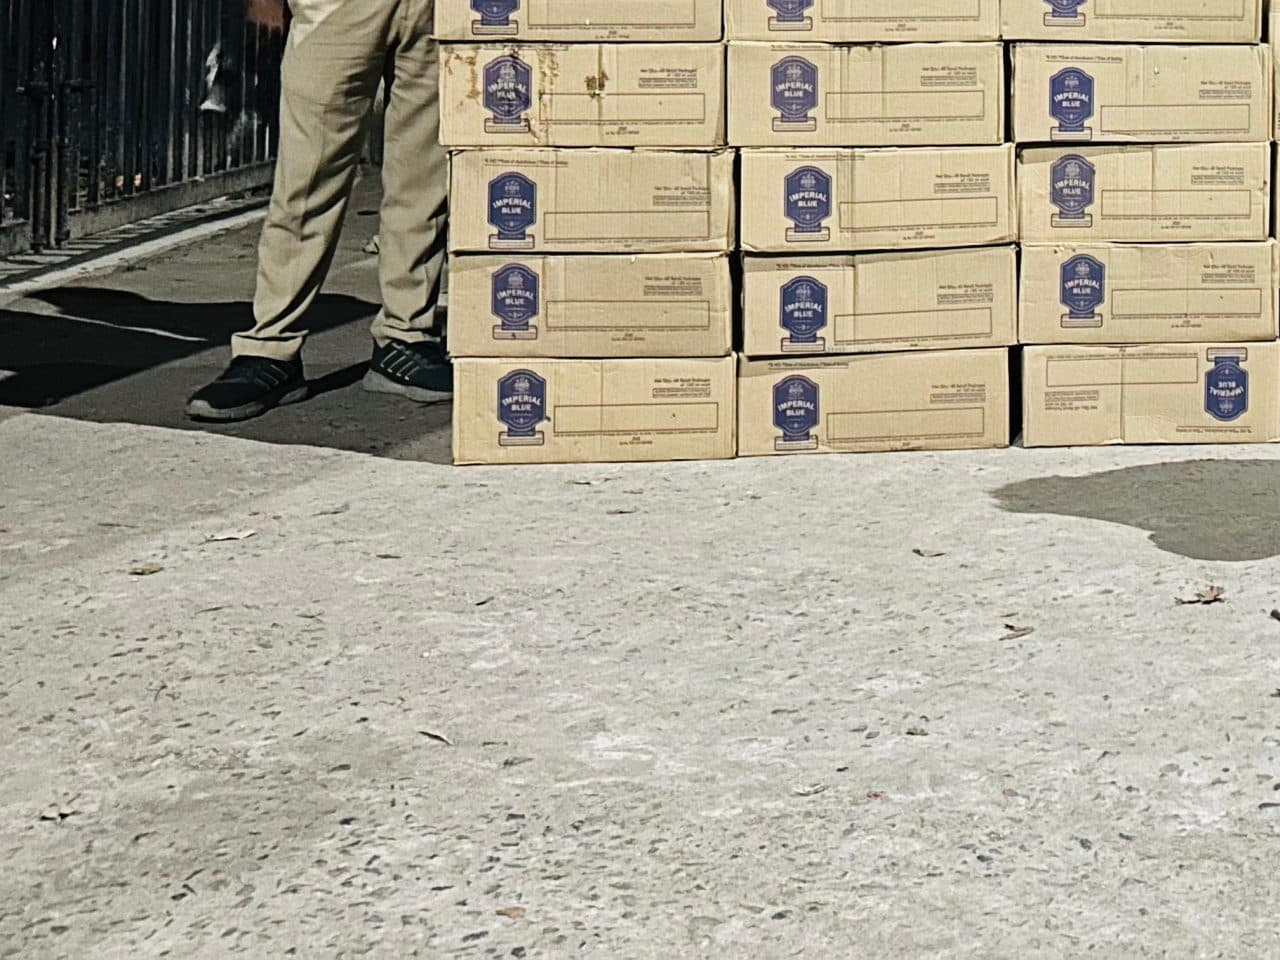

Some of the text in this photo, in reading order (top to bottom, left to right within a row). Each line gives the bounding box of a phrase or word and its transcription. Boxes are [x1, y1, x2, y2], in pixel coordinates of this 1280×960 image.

[775, 81, 813, 93] IMPERIAL
[1053, 92, 1089, 103] IMPERIAL
[1054, 179, 1090, 190] IMPERIAL
[788, 191, 827, 202] IMPERIAL
[492, 197, 531, 209] IMPERIAL
[1064, 278, 1100, 290] IMPERIAL
[496, 289, 534, 300] IMPERIAL
[784, 301, 822, 313] IMPERIAL
[793, 310, 814, 318] BLUE
[502, 394, 541, 406] IMPERIAL
[777, 400, 815, 412] IMPERIAL
